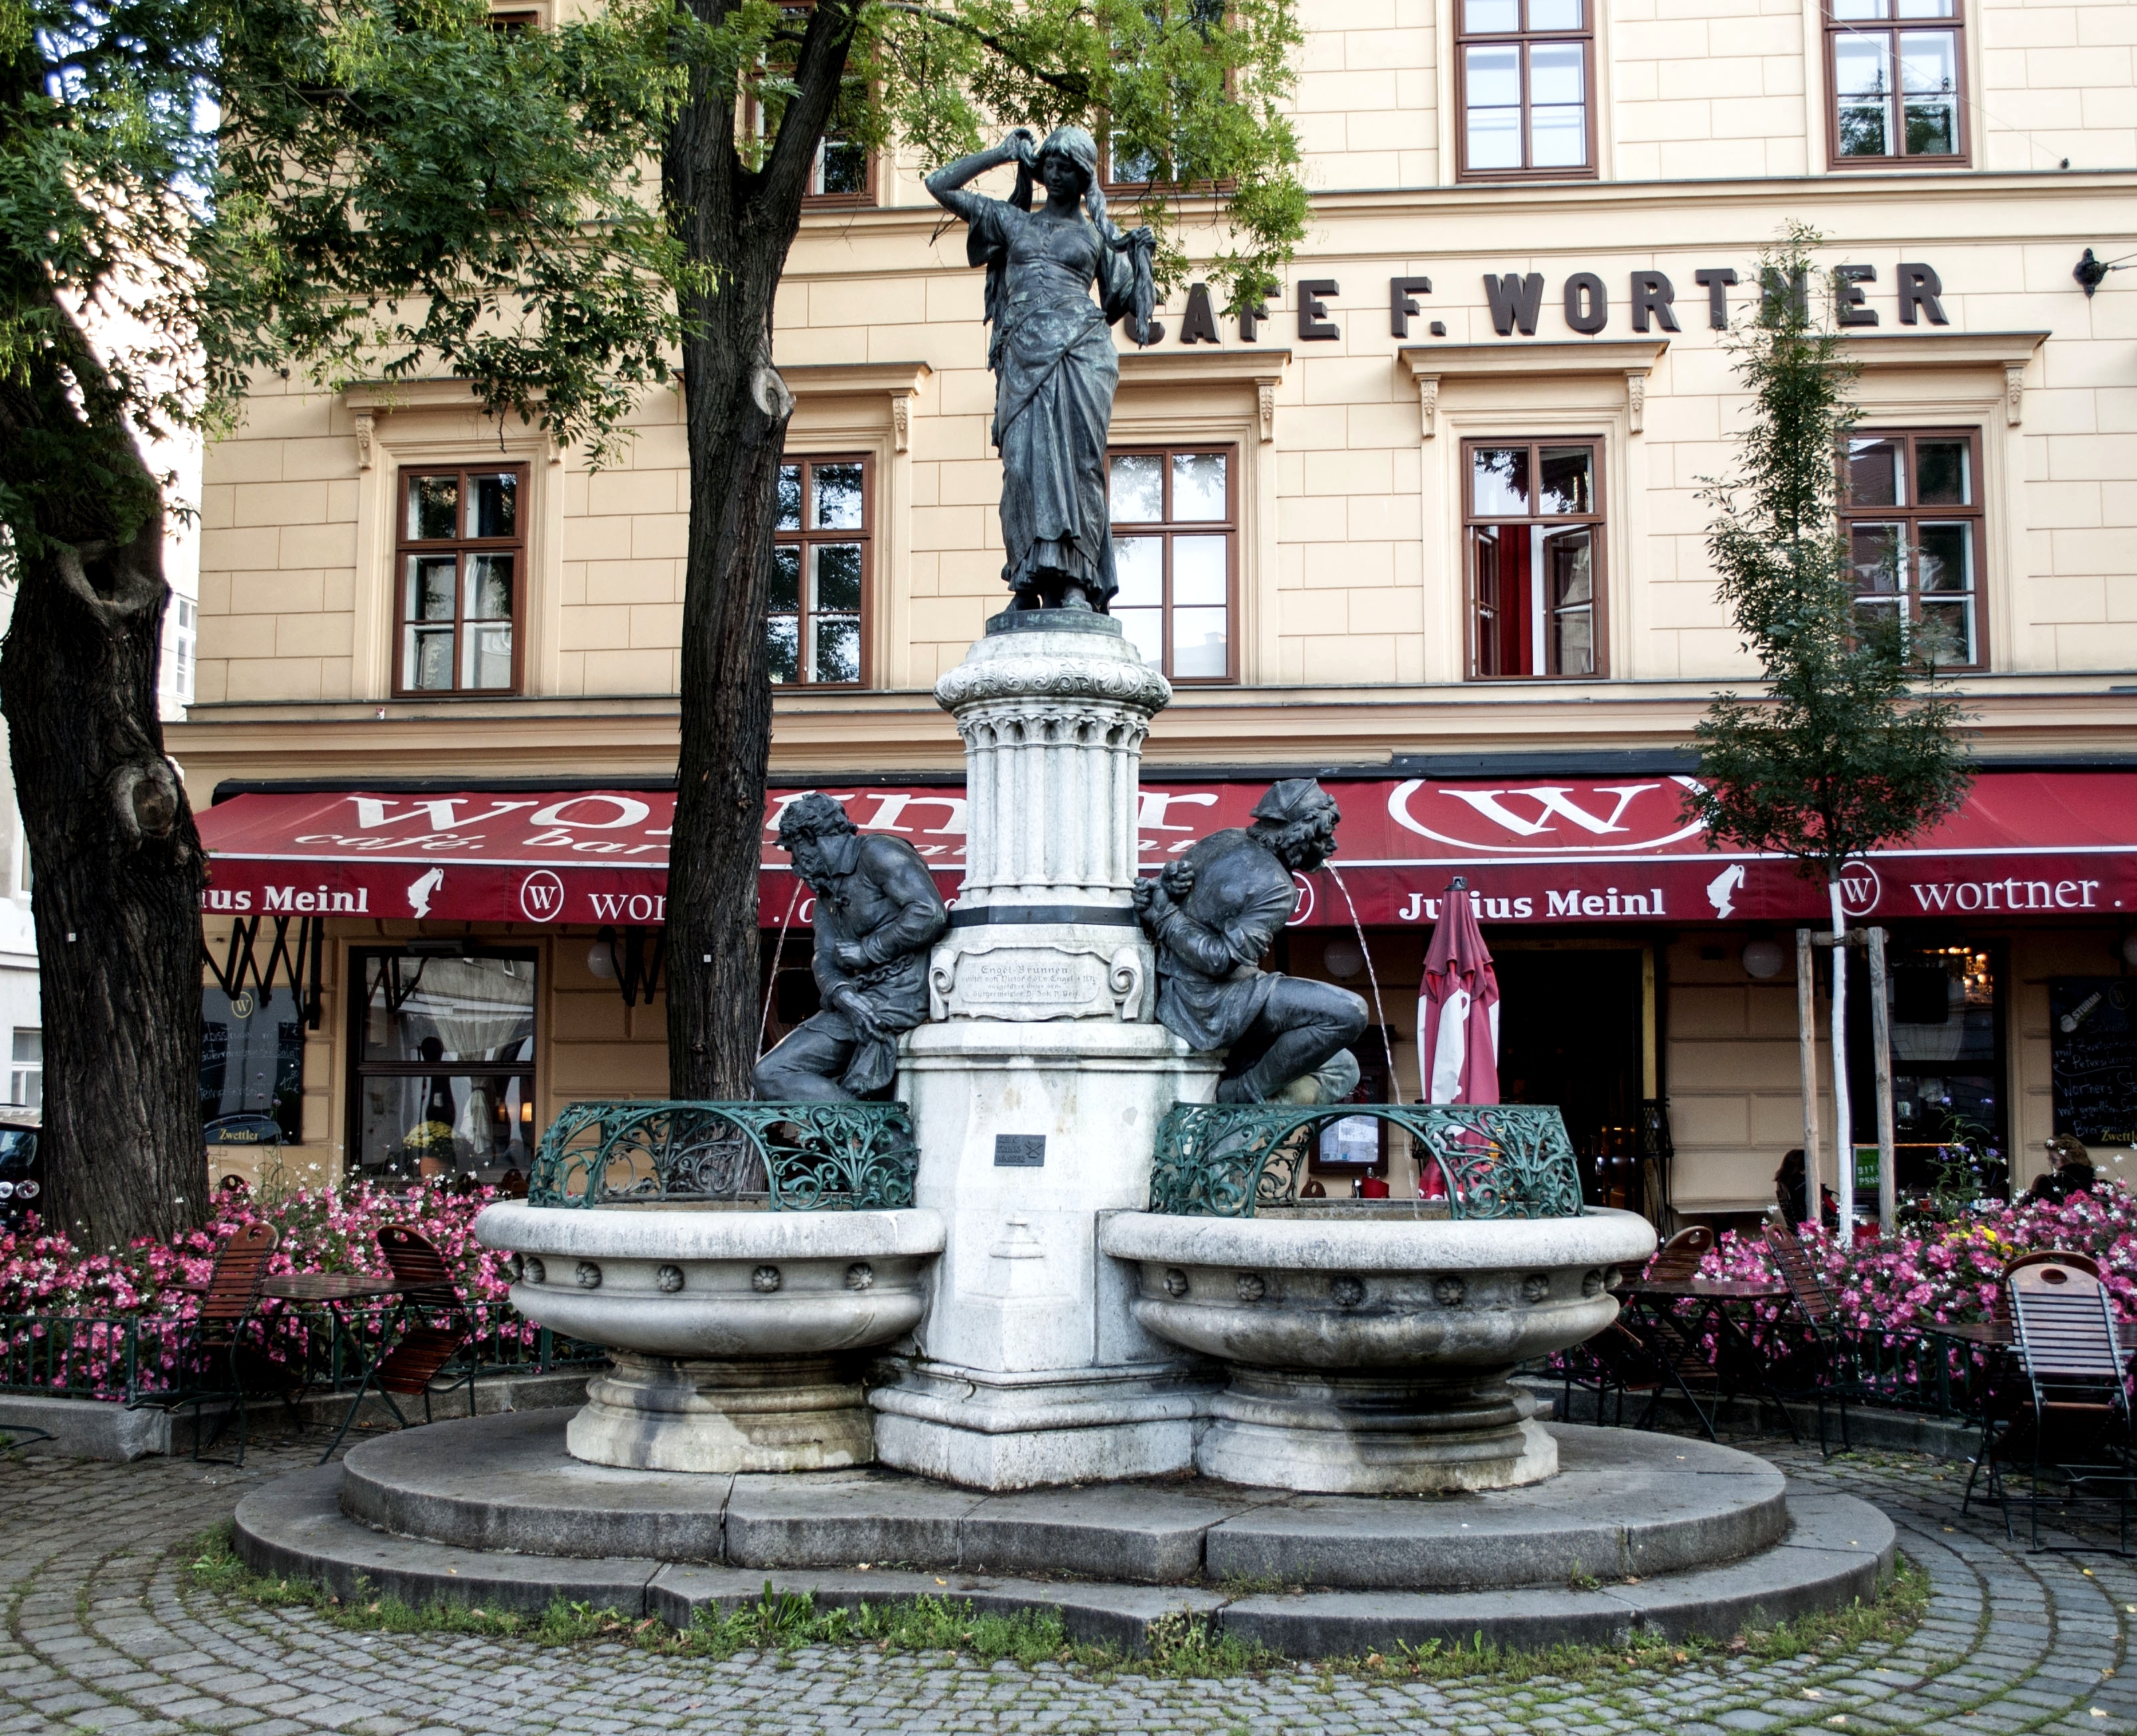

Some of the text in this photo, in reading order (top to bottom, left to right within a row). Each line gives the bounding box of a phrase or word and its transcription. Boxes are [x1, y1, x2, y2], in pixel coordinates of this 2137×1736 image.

[1390, 277, 1447, 338] F.
[1483, 263, 1949, 338] WORTNER
[263, 885, 369, 913] Meinl
[528, 885, 558, 911] W
[1399, 887, 1666, 920] Juius Meinl
[1840, 877, 1872, 903] W
[1911, 878, 2099, 911] wortner
[220, 1128, 259, 1141] Zwettler
